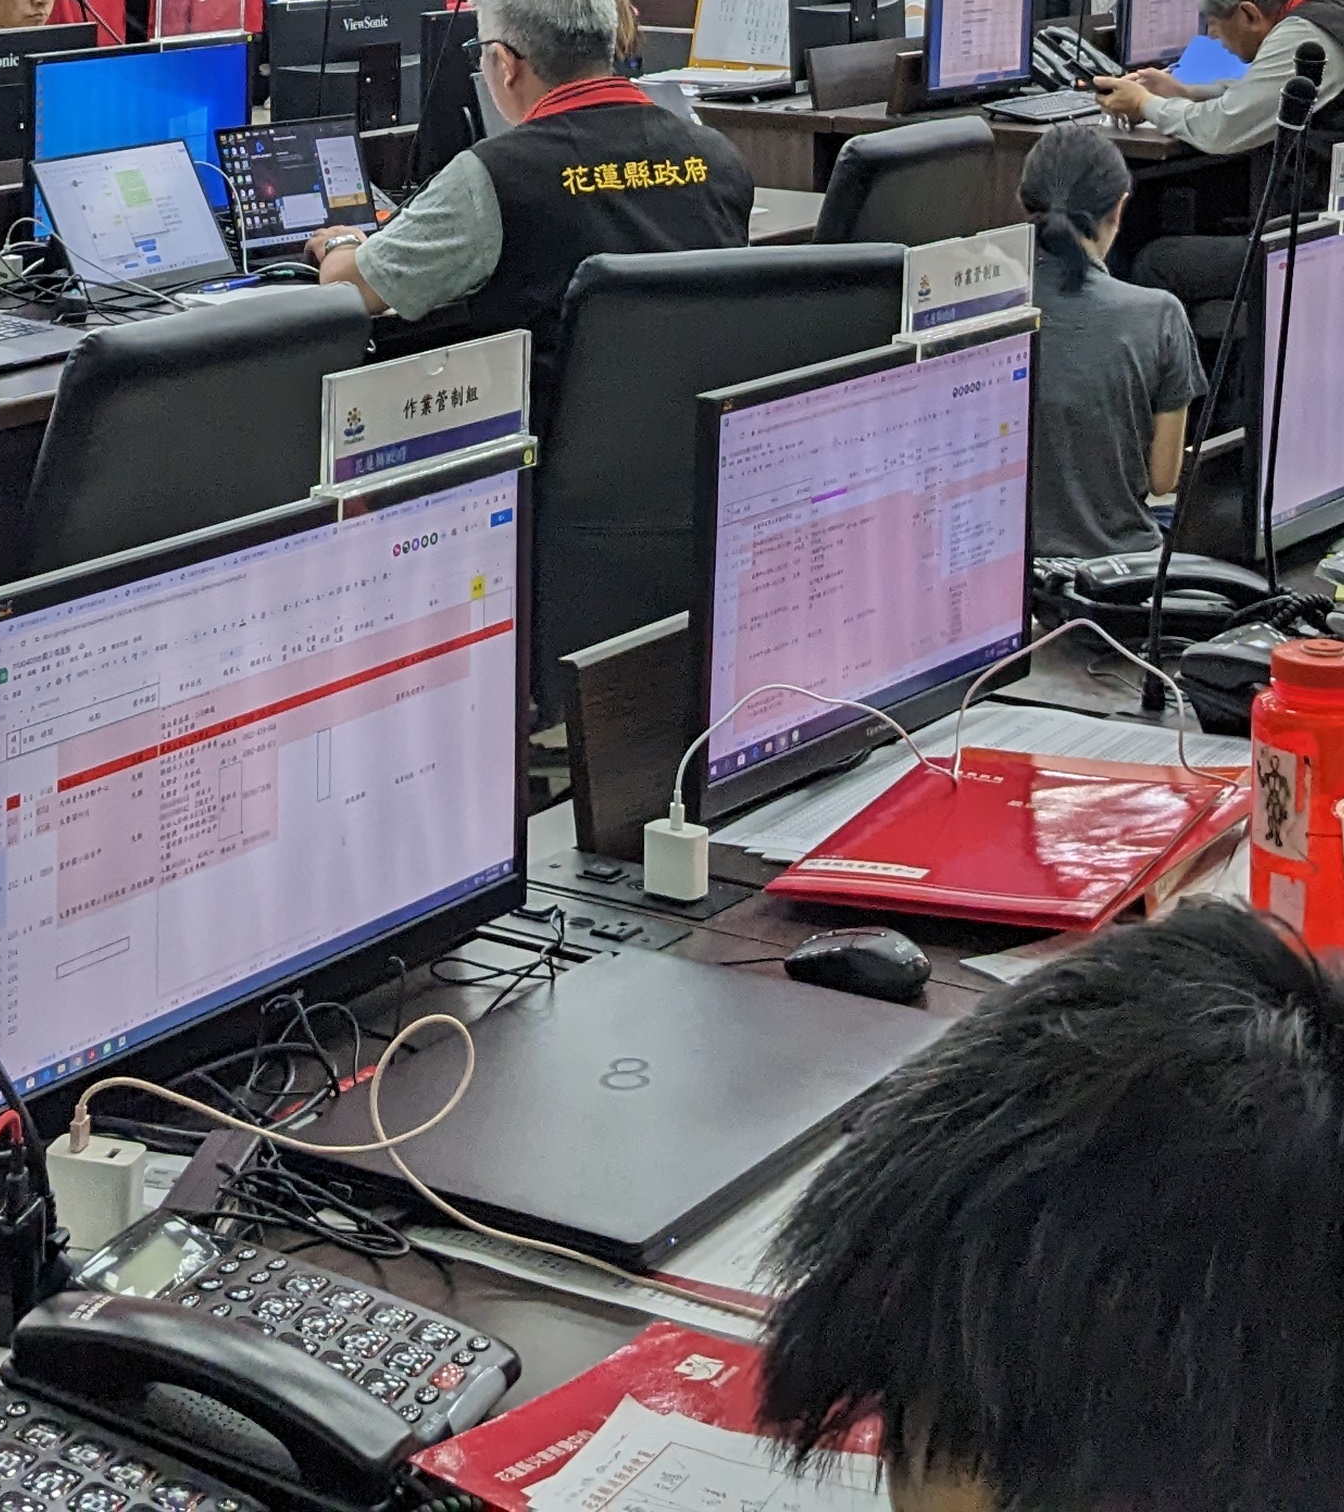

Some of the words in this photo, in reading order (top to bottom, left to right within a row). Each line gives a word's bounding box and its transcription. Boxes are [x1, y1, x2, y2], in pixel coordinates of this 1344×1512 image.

[342, 15, 389, 32] ViewSonic
[561, 156, 708, 195] 花蓮縣政府
[402, 384, 480, 420] 作業管制組
